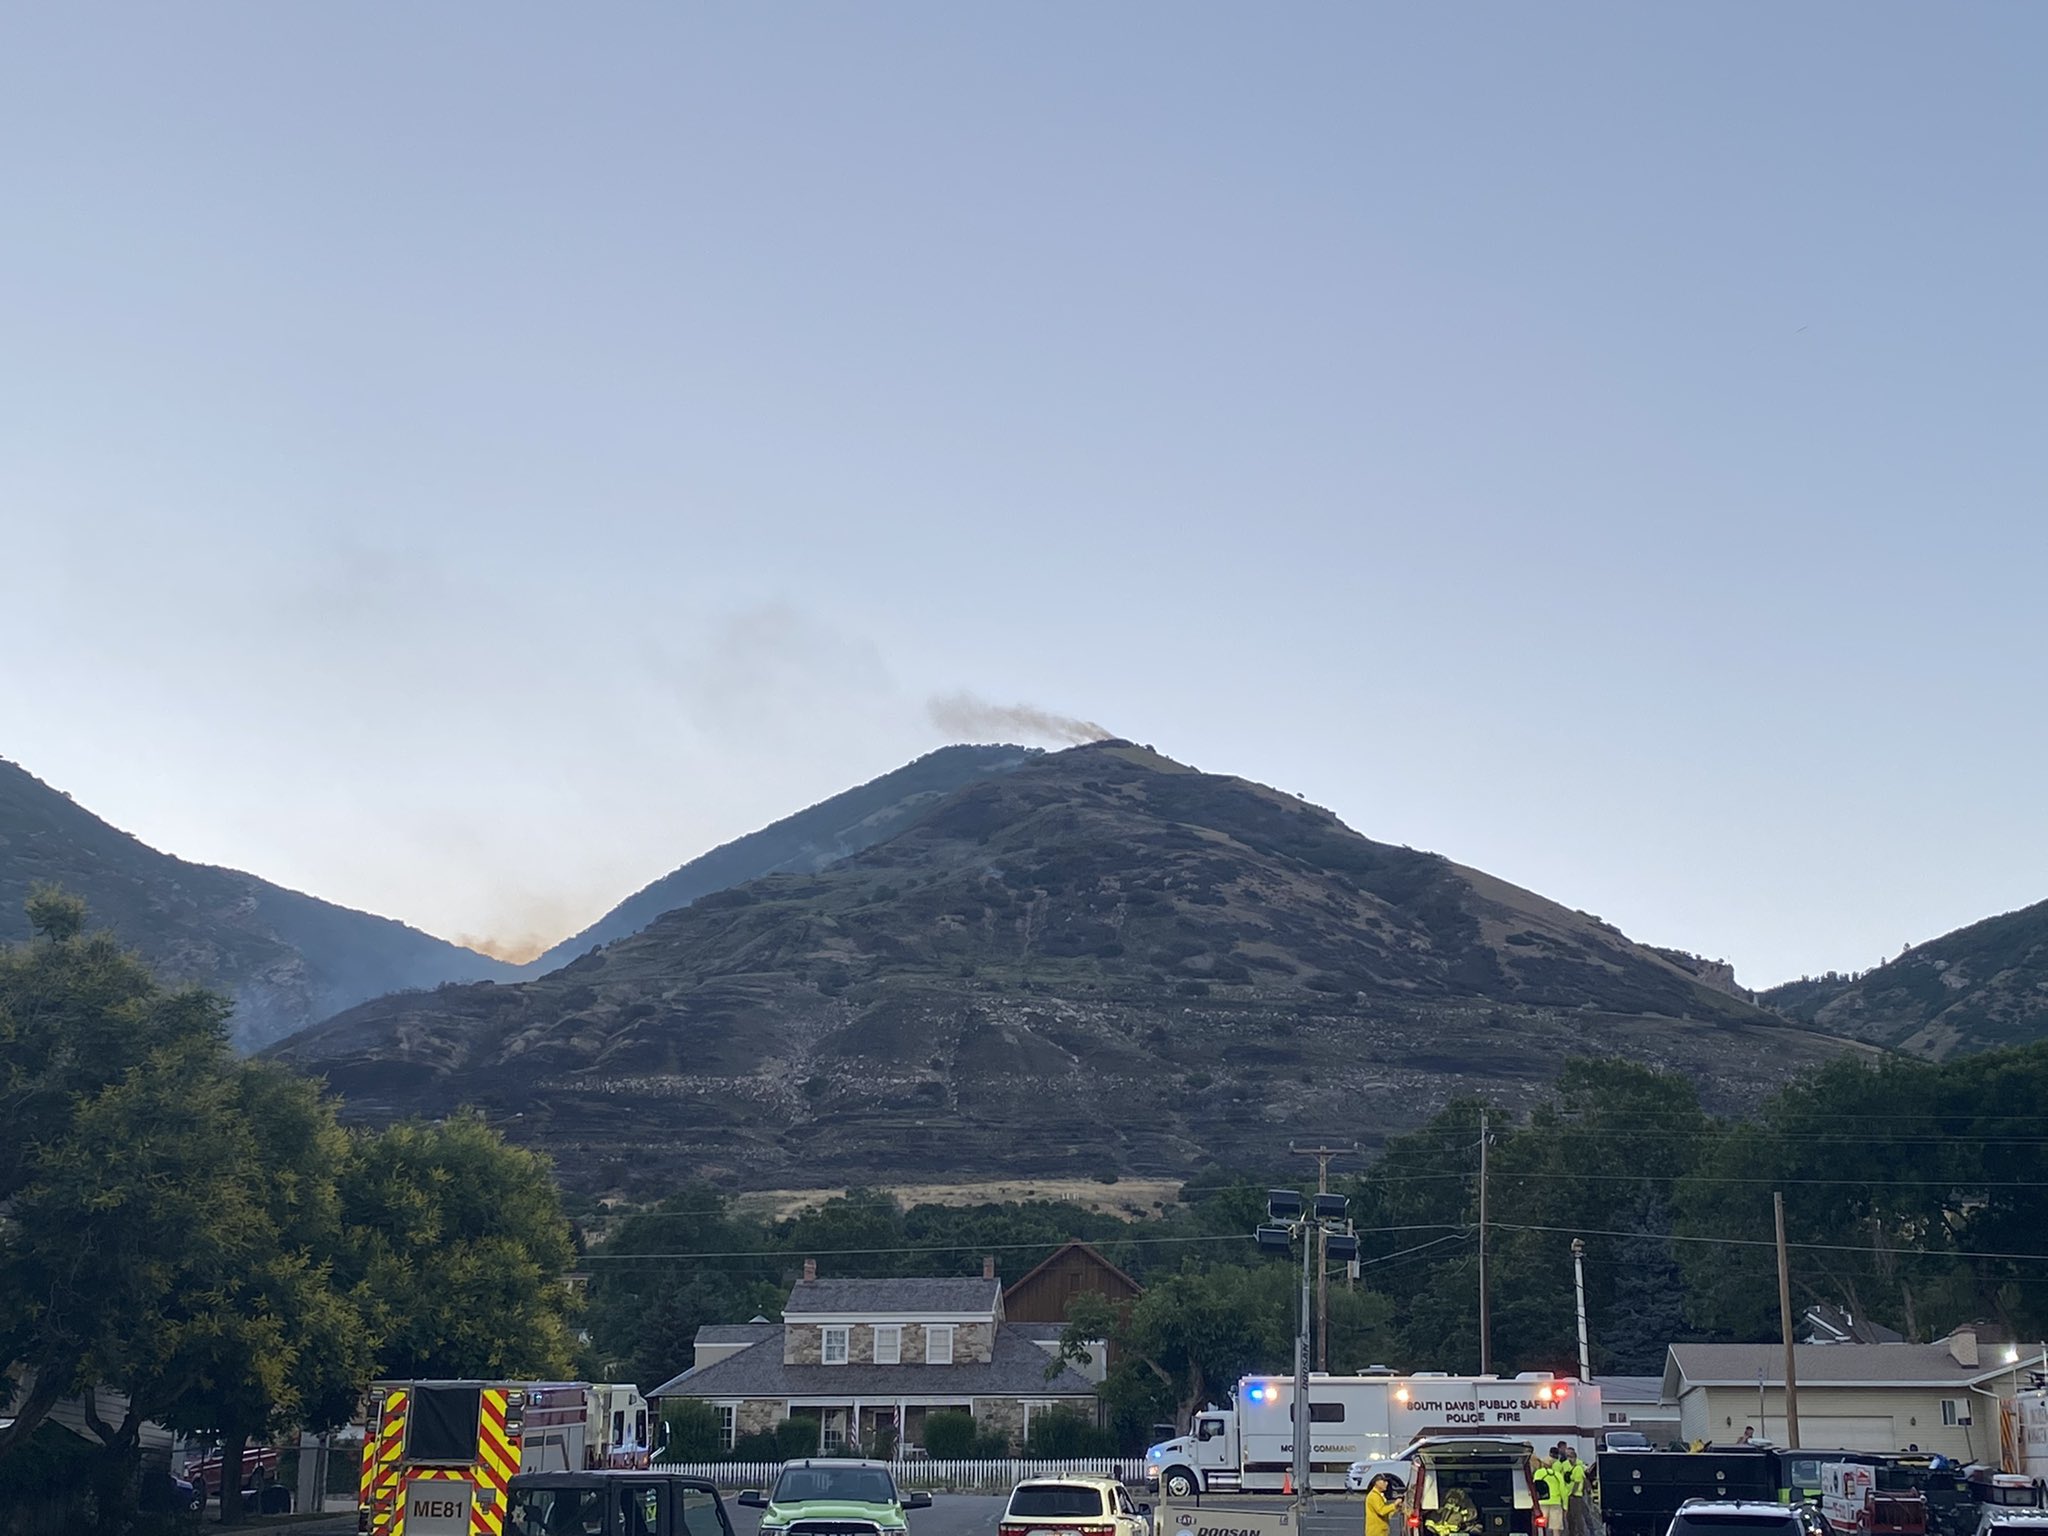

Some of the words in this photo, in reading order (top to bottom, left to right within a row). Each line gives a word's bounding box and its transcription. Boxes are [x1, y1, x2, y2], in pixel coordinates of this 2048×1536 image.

[1407, 1401, 1441, 1411] SOUTH
[1445, 1401, 1475, 1411] DAVIS
[1479, 1400, 1517, 1409] PUBLIC
[1520, 1400, 1560, 1410] SAFETY
[1446, 1412, 1485, 1423] POLICE
[1497, 1412, 1521, 1422] FIRE
[1313, 1444, 1357, 1452] COMMAND
[414, 1501, 462, 1518] ME81
[1198, 1528, 1261, 1536] DOOSAN
